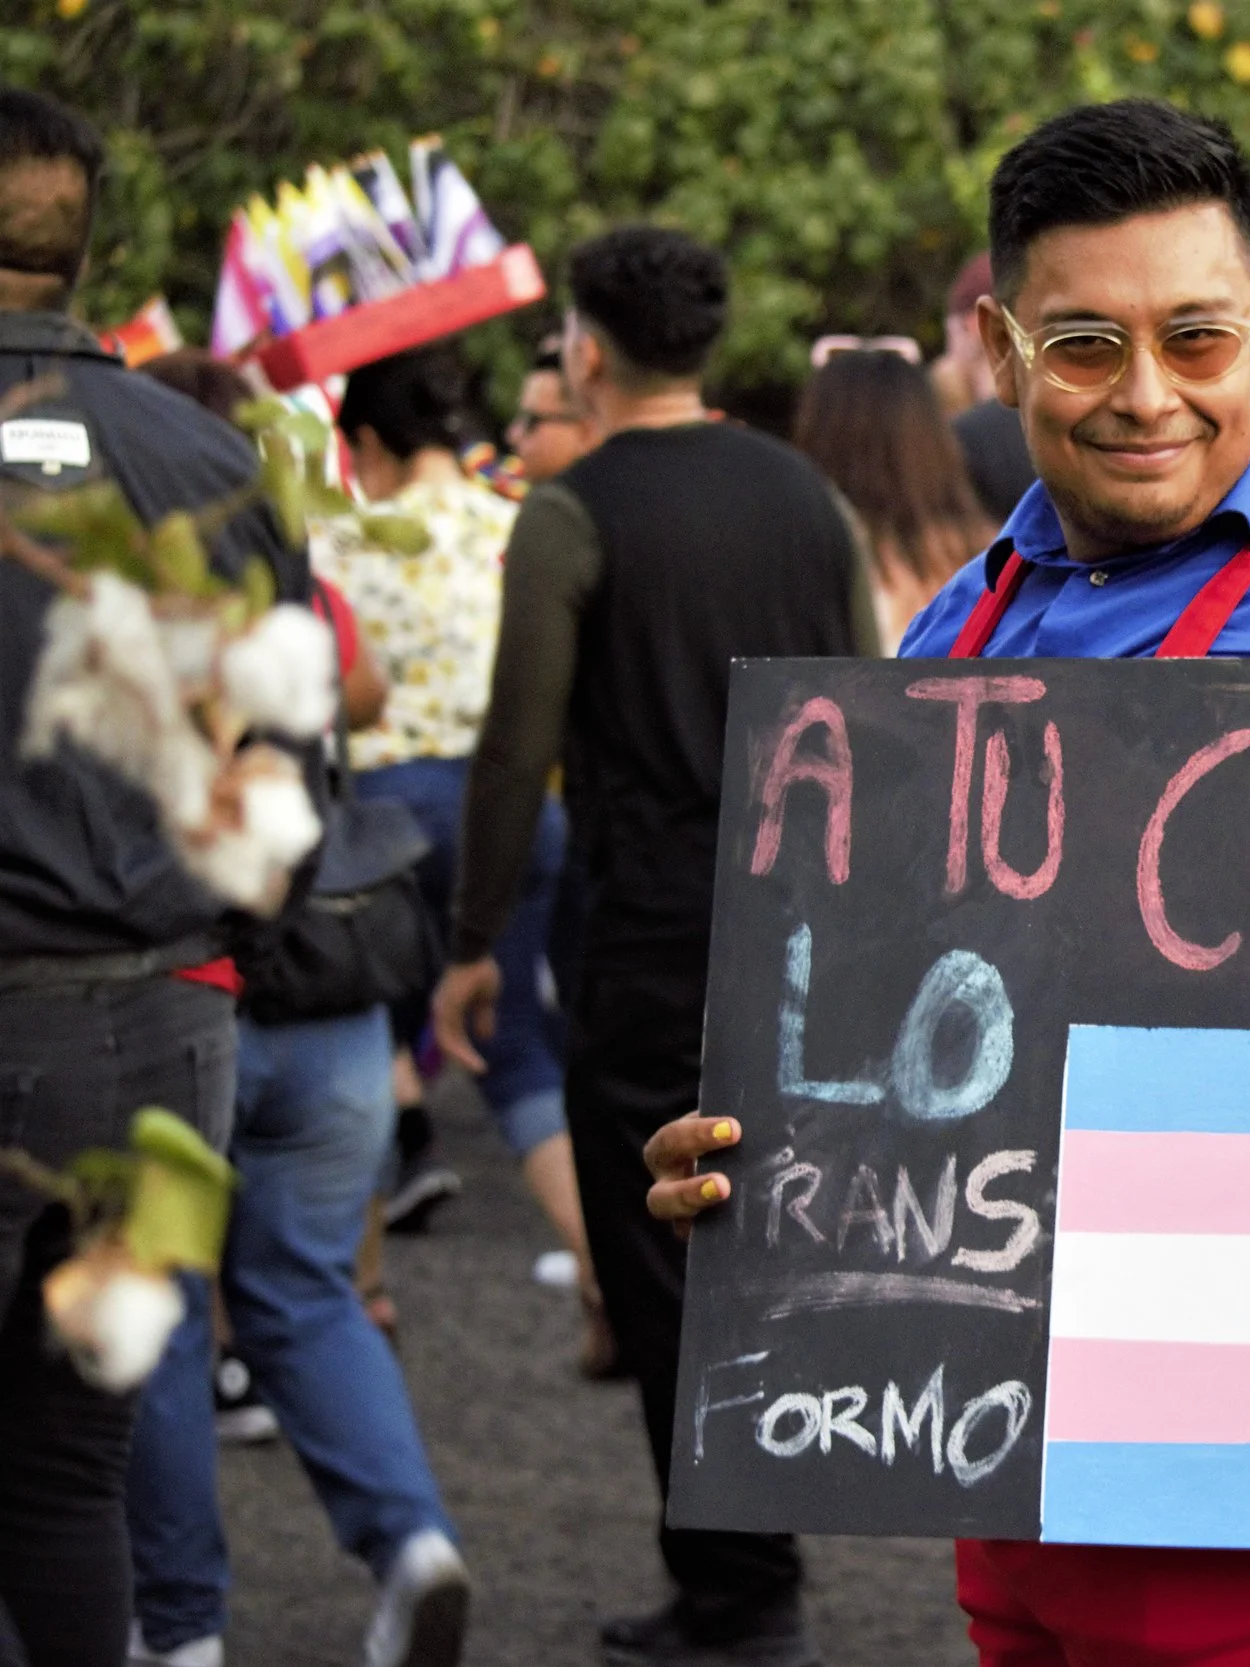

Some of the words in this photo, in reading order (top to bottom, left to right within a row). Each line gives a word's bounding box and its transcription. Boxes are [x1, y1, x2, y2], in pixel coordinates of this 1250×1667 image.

[750, 696, 854, 885] A
[905, 674, 1065, 900] TU
[777, 920, 1015, 1120] LO
[694, 1350, 1032, 1487] FORMO
